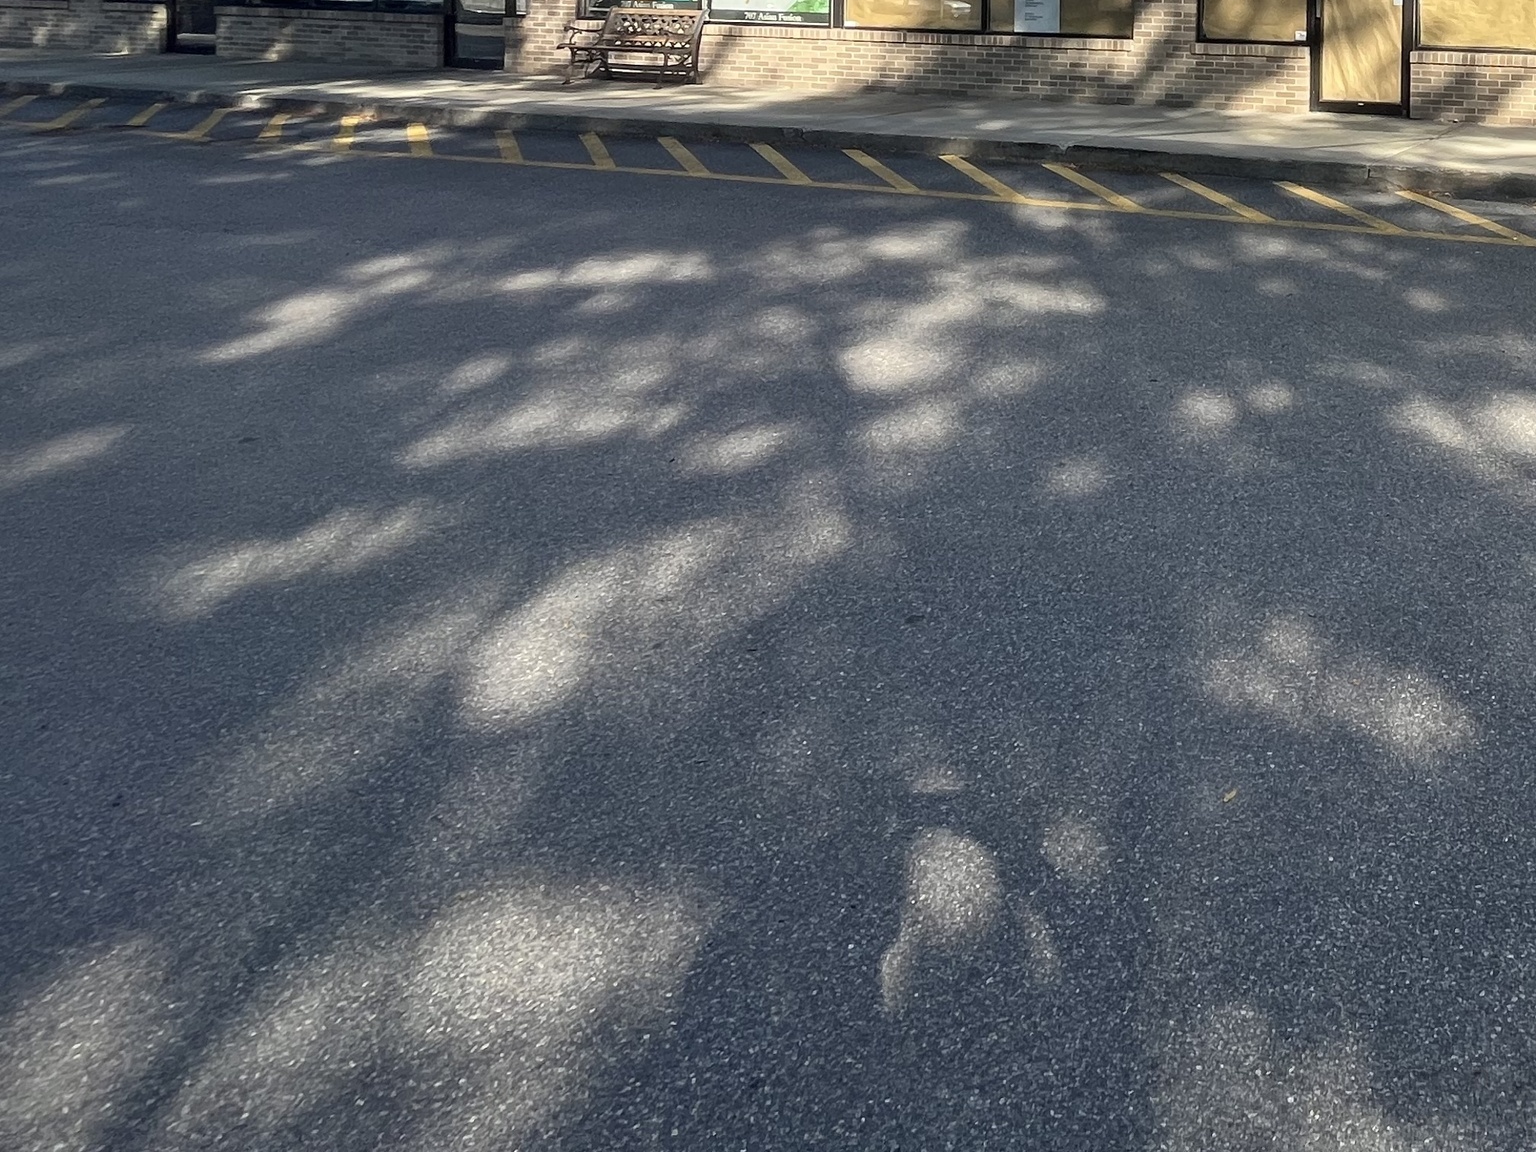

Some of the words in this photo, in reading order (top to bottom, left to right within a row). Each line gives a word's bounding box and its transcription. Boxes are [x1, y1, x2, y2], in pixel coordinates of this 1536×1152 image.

[744, 11, 756, 20] 707
[758, 12, 777, 21] Asian
[778, 13, 802, 22] Fusion
